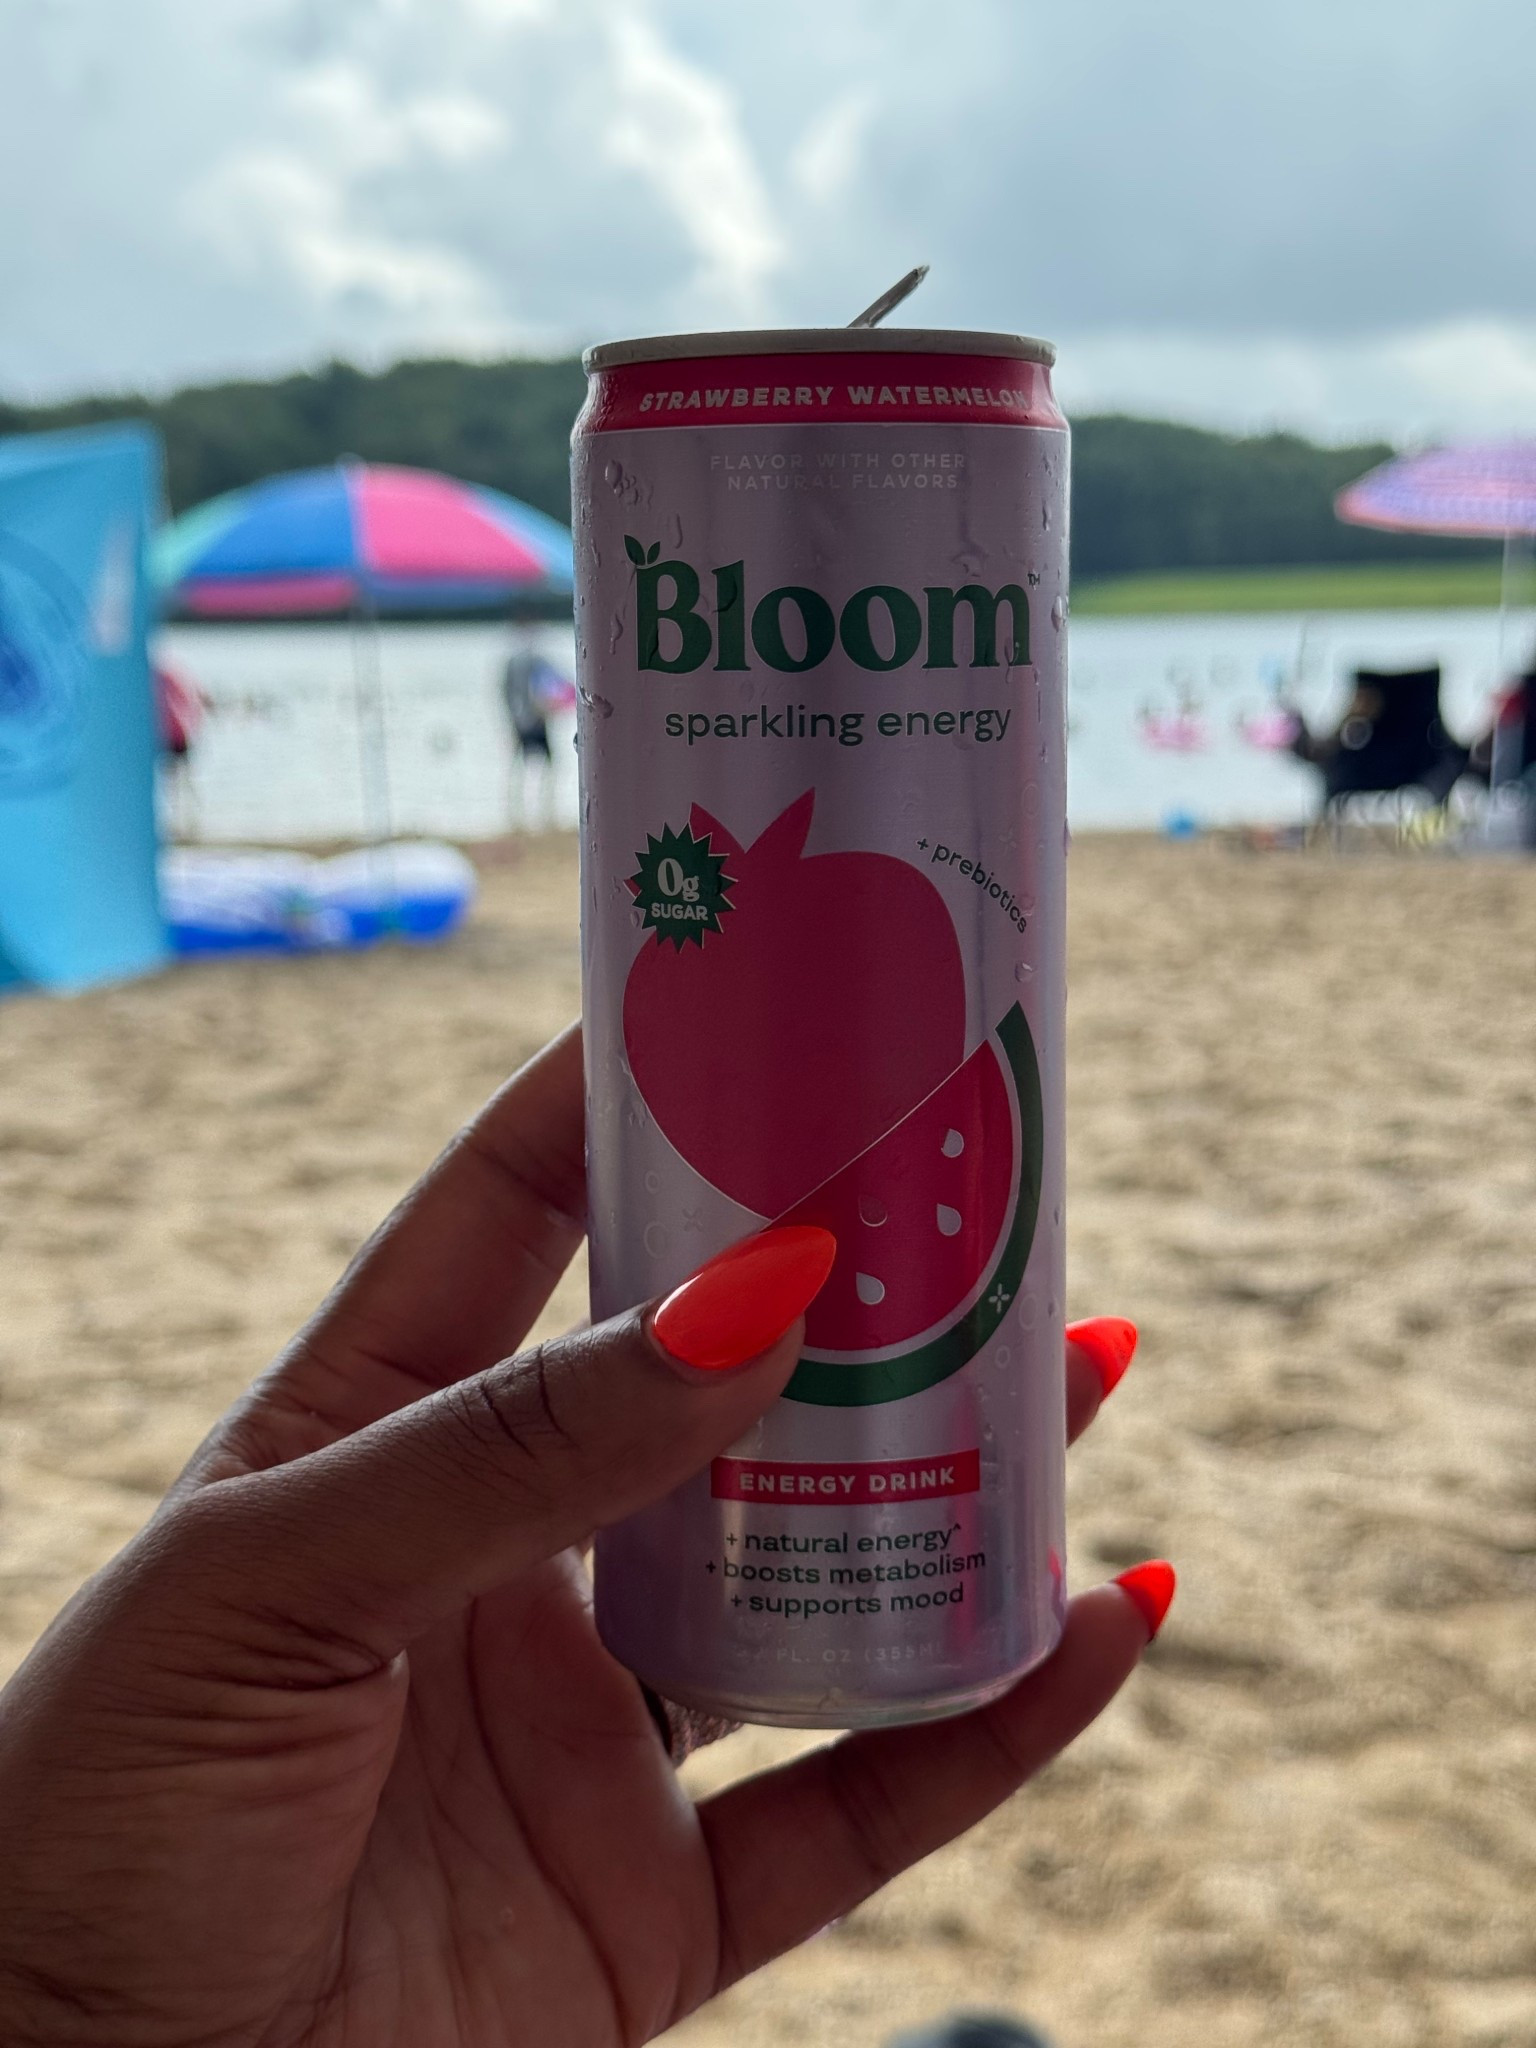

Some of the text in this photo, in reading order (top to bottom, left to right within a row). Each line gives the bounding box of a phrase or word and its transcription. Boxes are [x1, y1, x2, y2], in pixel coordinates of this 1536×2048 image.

[638, 385, 1029, 412] STRAWBERRY WATERMELON
[710, 453, 966, 471] FLAVOR WITH OTHER
[727, 473, 958, 491] NATURAL FLAVORS
[636, 559, 1033, 674] Bloom
[665, 704, 1012, 746] sparkling energy
[657, 857, 700, 902] 0g
[931, 843, 1027, 933] prebiotics
[651, 902, 708, 921] SUGAR
[738, 1465, 956, 1495] ENERGY DRINK
[744, 1531, 849, 1553] natural
[723, 1557, 821, 1584] boosts
[829, 1550, 986, 1584] metabolism
[749, 1594, 882, 1619] supports
[890, 1582, 965, 1612] mood
[822, 1649, 852, 1663] OZ
